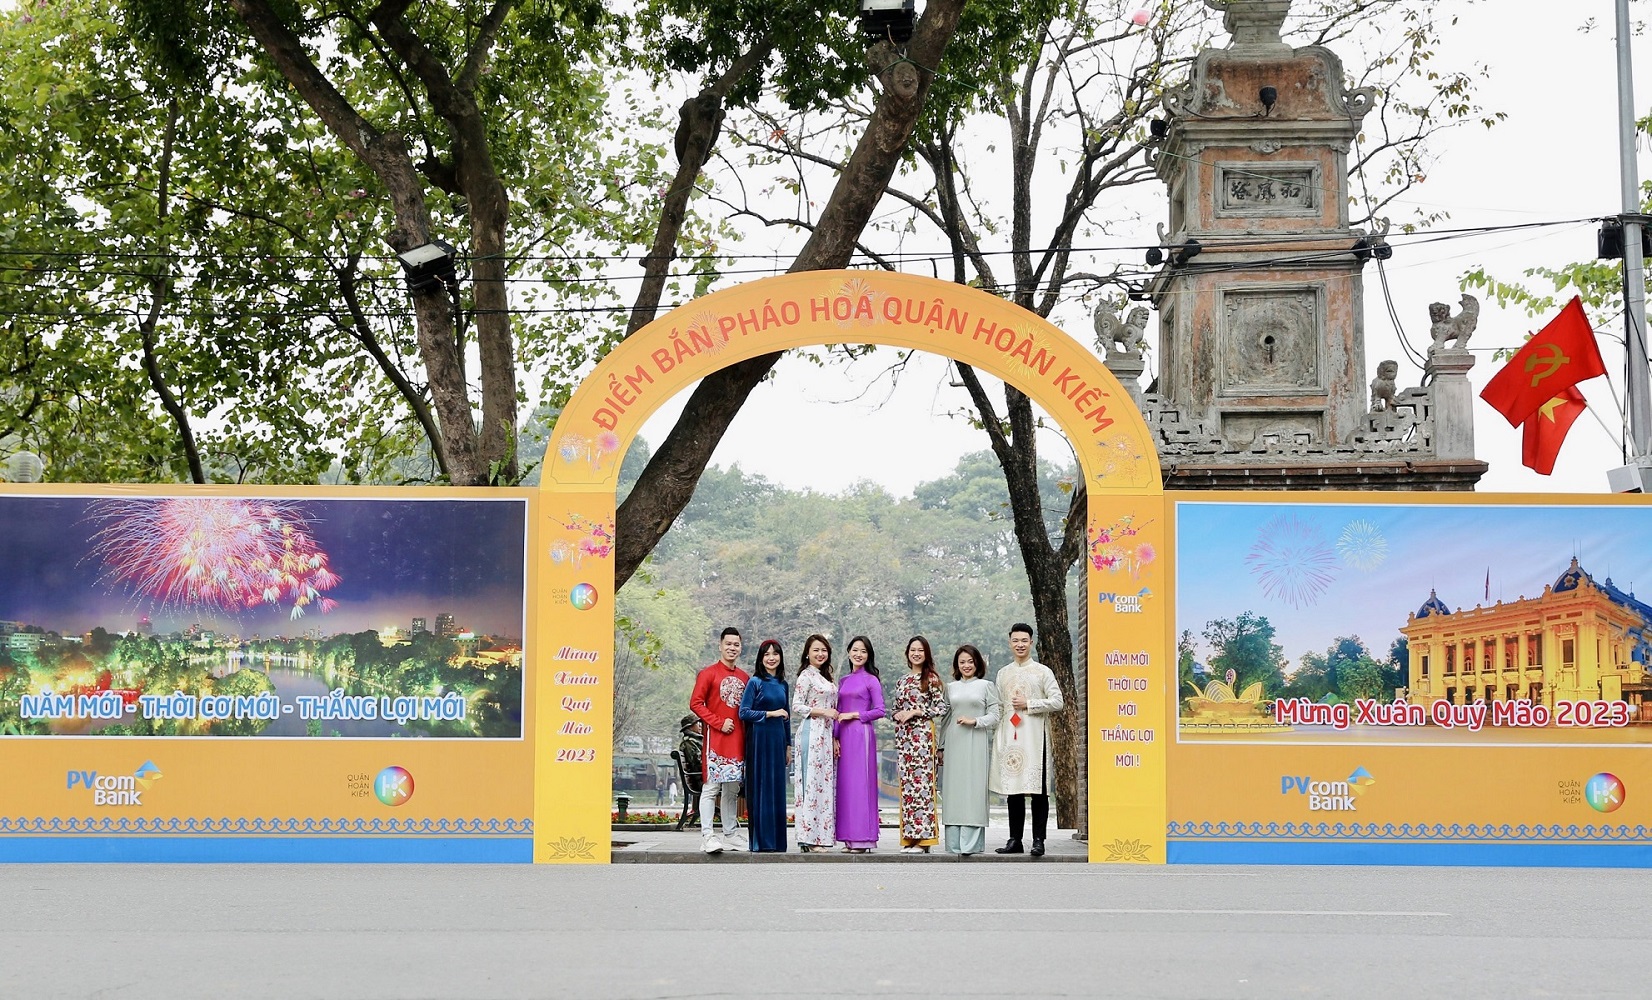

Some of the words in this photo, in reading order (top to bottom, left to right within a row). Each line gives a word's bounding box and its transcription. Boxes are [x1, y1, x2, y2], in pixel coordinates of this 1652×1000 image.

[591, 372, 655, 431] ĐIỂM
[651, 327, 714, 374] BẮN
[717, 298, 801, 342] PHÁO
[810, 295, 874, 322] HOA
[882, 296, 968, 334] QUẬN
[972, 317, 1056, 376] HOÀN
[1052, 366, 1115, 434] KIẾM
[1114, 603, 1143, 613] Bank
[553, 646, 599, 663] Mừng
[1105, 650, 1128, 665] NĂM
[1130, 650, 1149, 666] MỚI
[554, 671, 599, 685] Xuân
[1107, 675, 1131, 691] THỜI
[1133, 678, 1148, 691] CƠ
[22, 691, 73, 717] NĂM
[79, 691, 121, 717] MỚI
[140, 691, 195, 717] THỜI
[200, 696, 232, 717] CƠ
[236, 693, 278, 718] MỚI
[297, 688, 377, 718] THẮNG
[382, 696, 417, 724] LỢI
[423, 692, 464, 718] MỚI
[561, 696, 592, 712] Quý
[1118, 701, 1137, 716] MỚI
[1276, 698, 1349, 729] Mừng
[1356, 698, 1425, 724] Xuân
[1433, 700, 1486, 730] Quý
[1493, 700, 1549, 725] Mão
[1557, 701, 1628, 725] 2023
[1101, 724, 1136, 741] THẮNG
[1138, 729, 1154, 744] LỢI
[556, 749, 596, 762] 2023
[1115, 752, 1134, 767] MỚI
[94, 790, 142, 805] Bank
[1309, 795, 1356, 811] Bank
